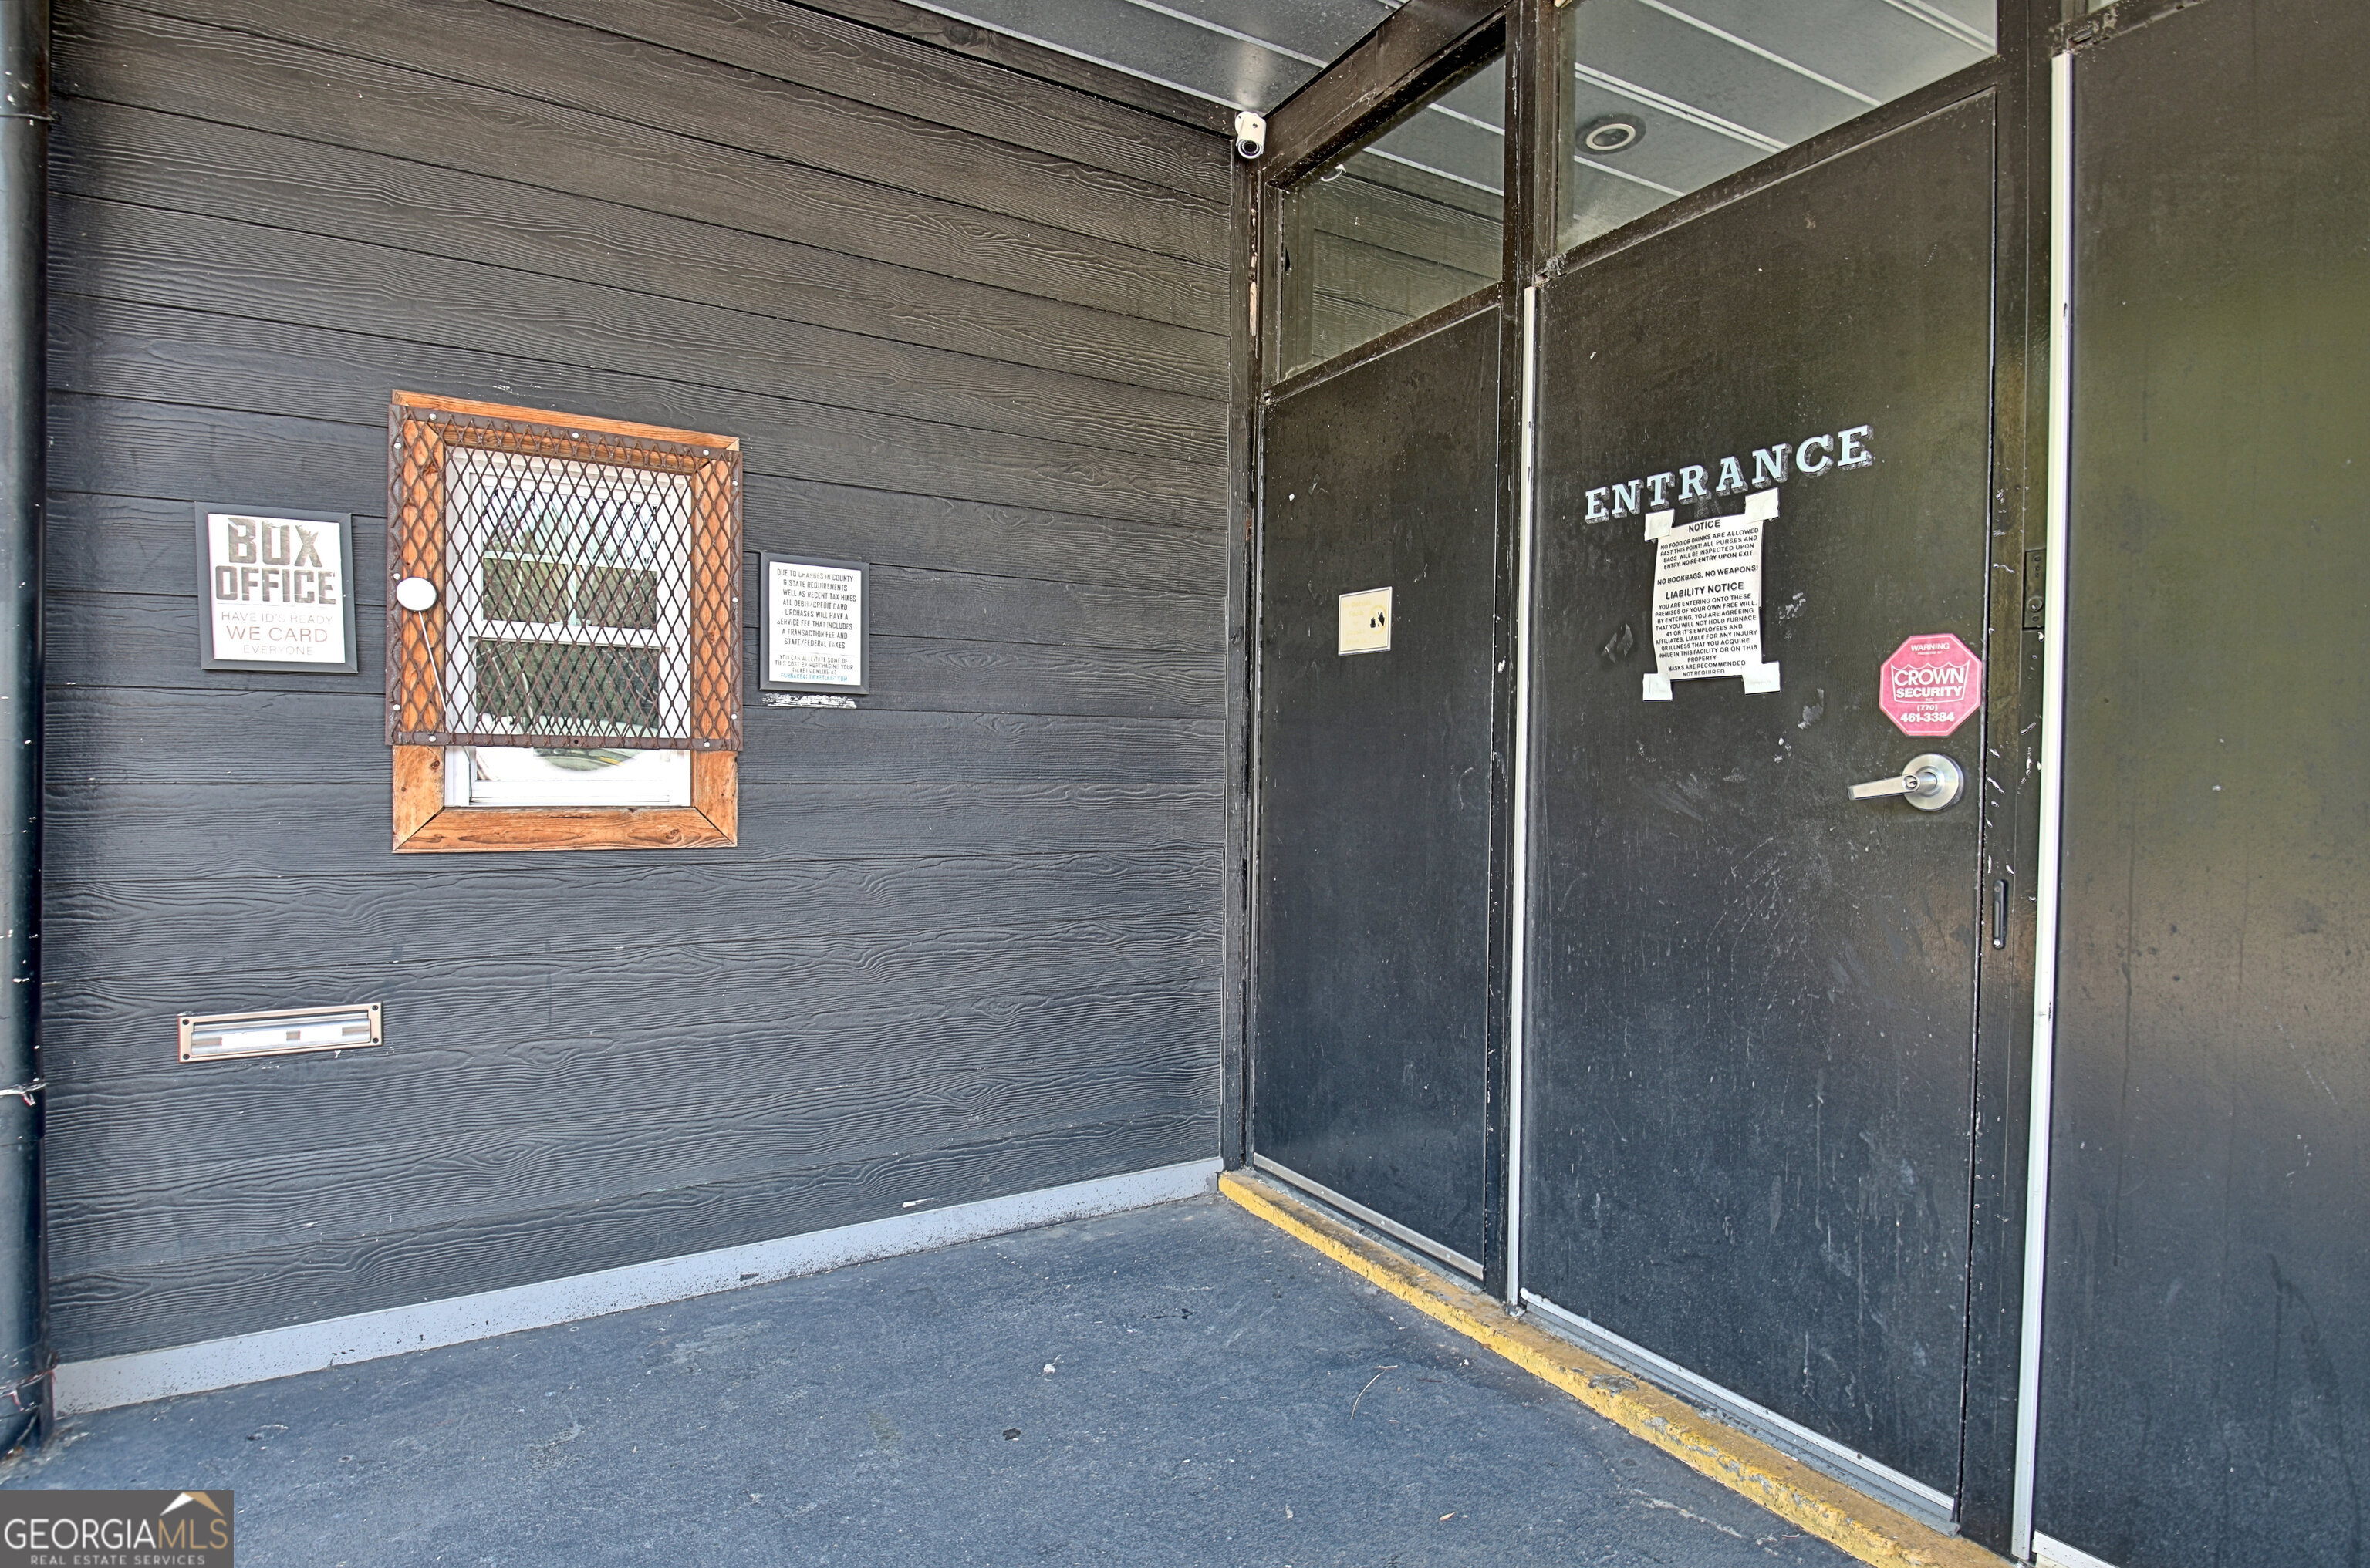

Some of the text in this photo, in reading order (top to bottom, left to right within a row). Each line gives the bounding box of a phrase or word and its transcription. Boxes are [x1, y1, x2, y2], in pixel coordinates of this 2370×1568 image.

[1585, 424, 1874, 524] ENTRANCE
[1689, 519, 1720, 532] NOTICE
[1691, 534, 1711, 544] DRINKS
[1727, 528, 1759, 537] ALLOWED
[228, 518, 322, 568] BOX
[1700, 545, 1734, 555] INSPECTED
[1690, 555, 1717, 564] RE-ENTRY
[1717, 565, 1758, 575] WEAPONS!
[832, 574, 853, 582] COUNTY
[215, 565, 336, 605] OFFICE
[788, 579, 805, 588] STATE
[807, 582, 848, 592] REQUIREMENTS
[783, 588, 797, 597] WELL
[807, 591, 828, 599] RECENT
[1666, 582, 1744, 600] LIABILITY NOTICE
[1682, 599, 1710, 607] ENTERING
[784, 609, 814, 618] URCHASES
[1655, 609, 1680, 618] PREMISES
[1721, 608, 1754, 616] AGREEING
[221, 612, 332, 624] HAVE ID'S READY
[1727, 614, 1757, 623] FURNACE
[777, 618, 799, 626] SERVICE
[826, 622, 853, 630] INCLUDES
[1693, 625, 1727, 633] EMPLOYEES
[226, 626, 328, 642] WE CARD
[788, 628, 825, 638] TRANSACTION
[784, 638, 827, 648] STATE/FEDERAL
[1911, 642, 1950, 652] WARNING
[243, 645, 312, 656] EVERYONE
[1693, 646, 1718, 655] FACILITY
[1697, 660, 1746, 669] RECOMMENDED
[1894, 667, 1964, 686] CROWN
[1896, 686, 1963, 698] SECURITY
[1900, 712, 1955, 723] 461-3384
